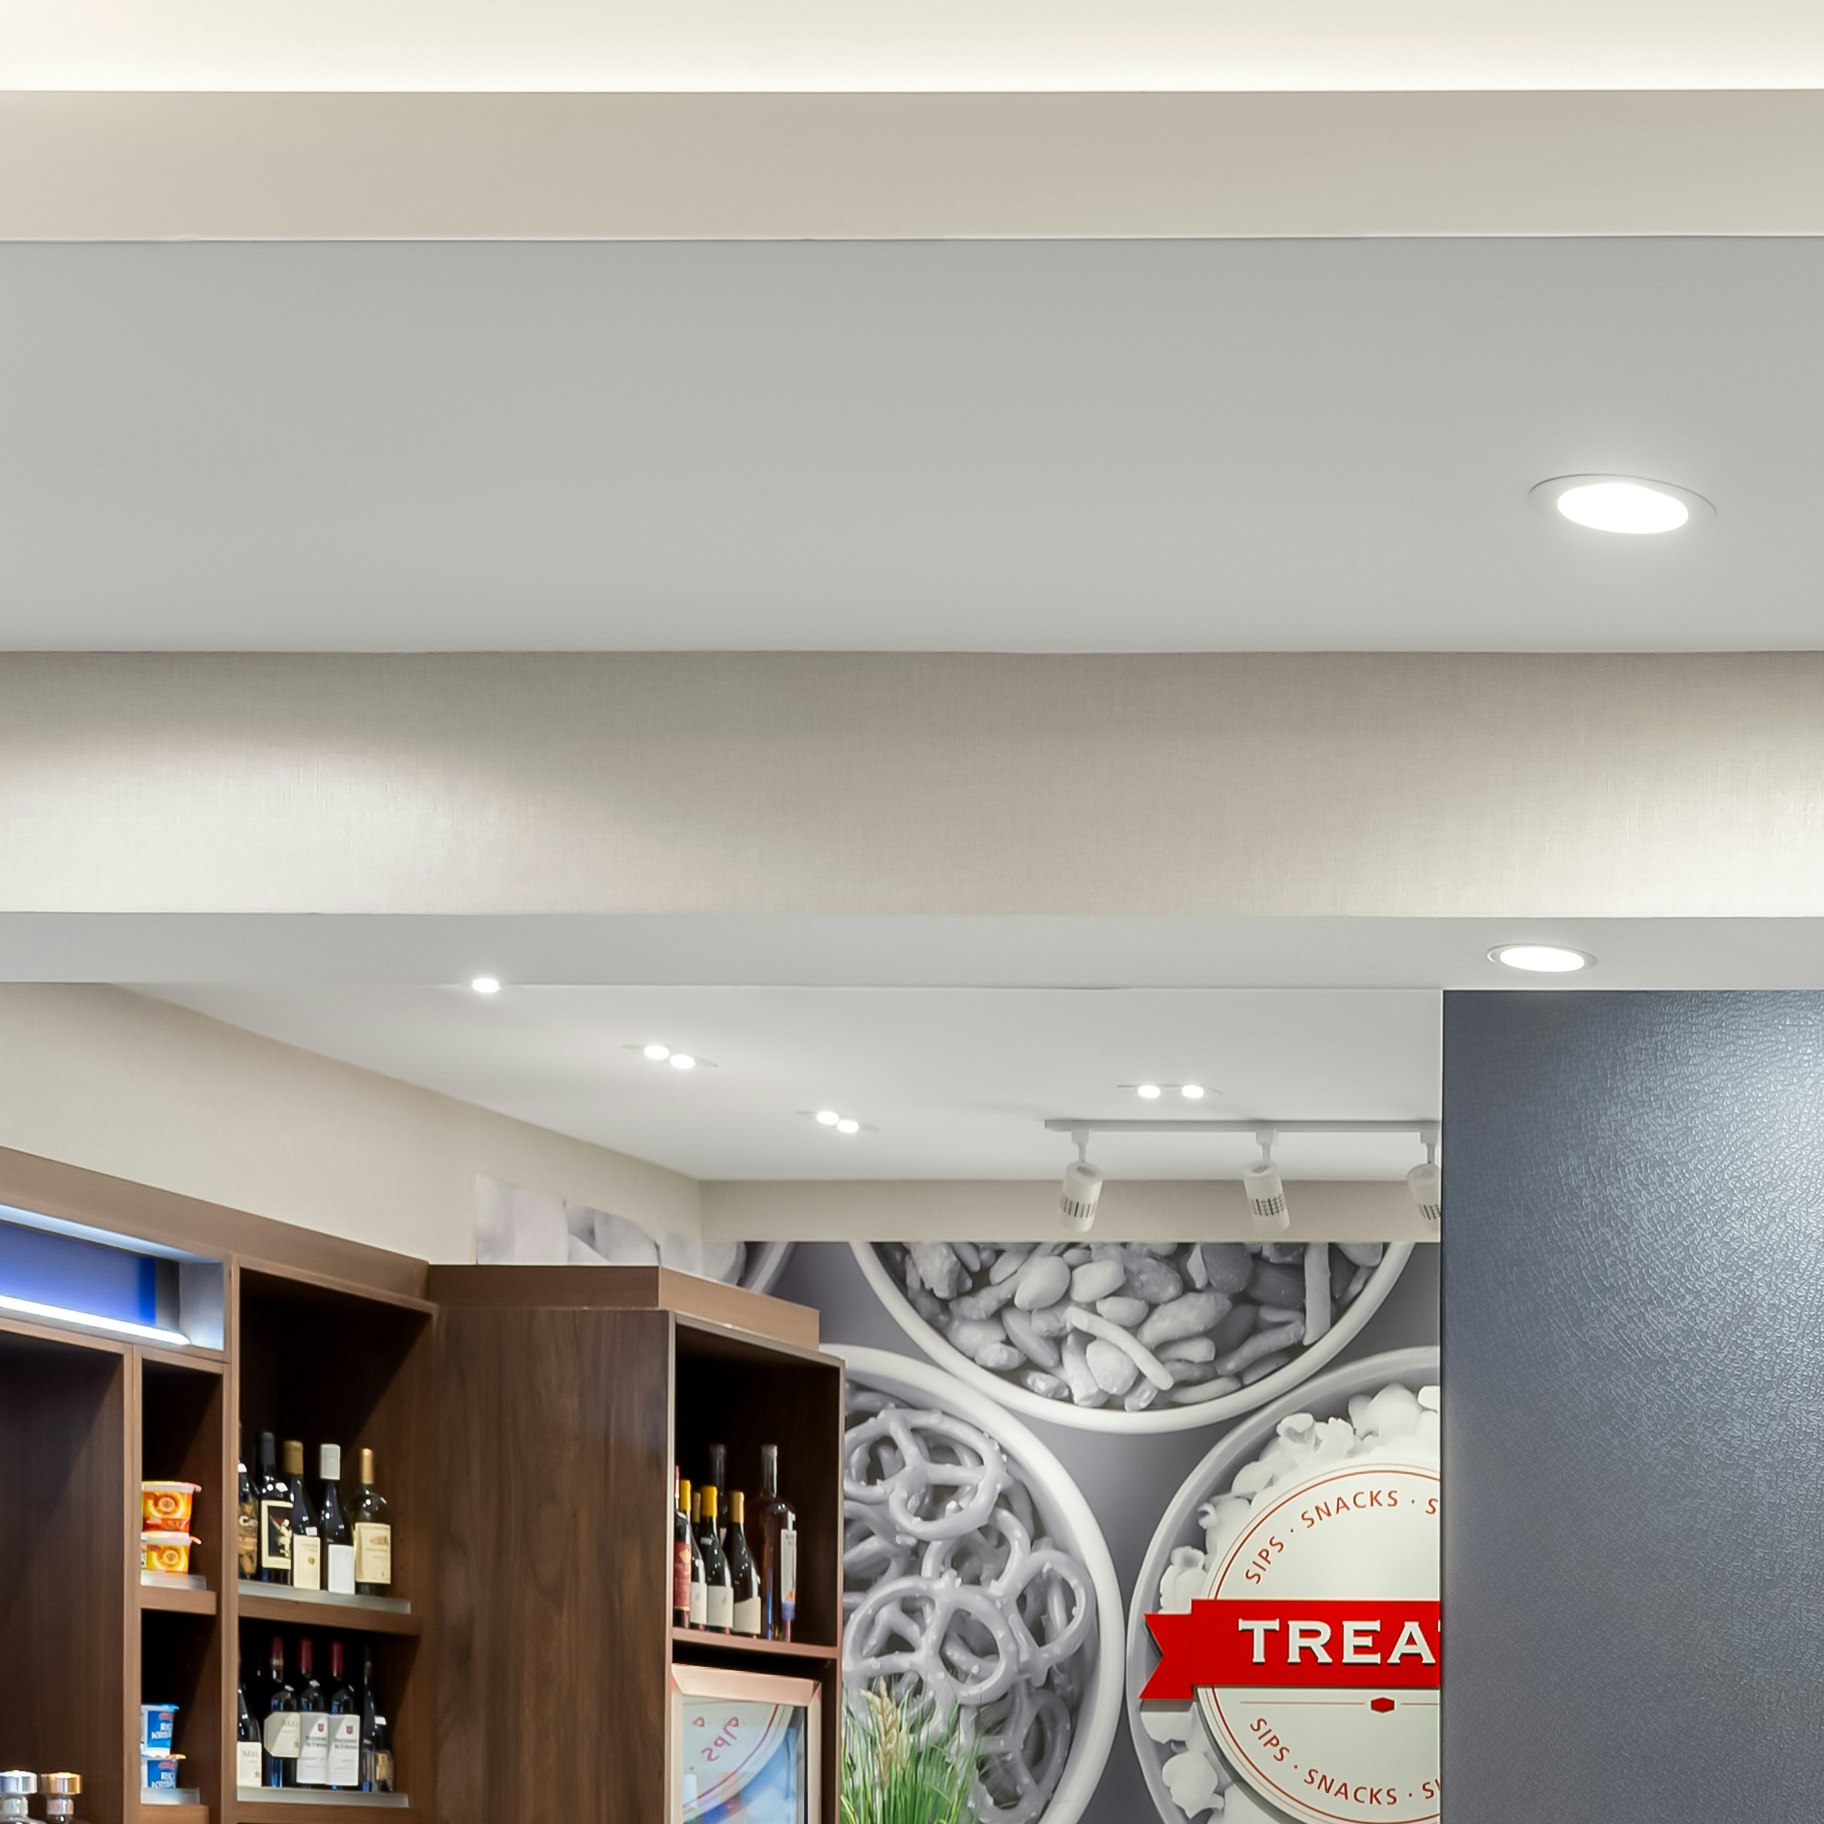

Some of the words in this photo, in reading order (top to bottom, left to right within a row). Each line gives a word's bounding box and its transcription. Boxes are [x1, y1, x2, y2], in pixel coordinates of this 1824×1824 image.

[1245, 1536, 1285, 1584] SIPS
[1301, 1490, 1398, 1528] SNACKS
[1238, 1618, 1440, 1664] TREA
[1250, 1718, 1290, 1762] SIPS
[1304, 1769, 1398, 1805] SNACKS
